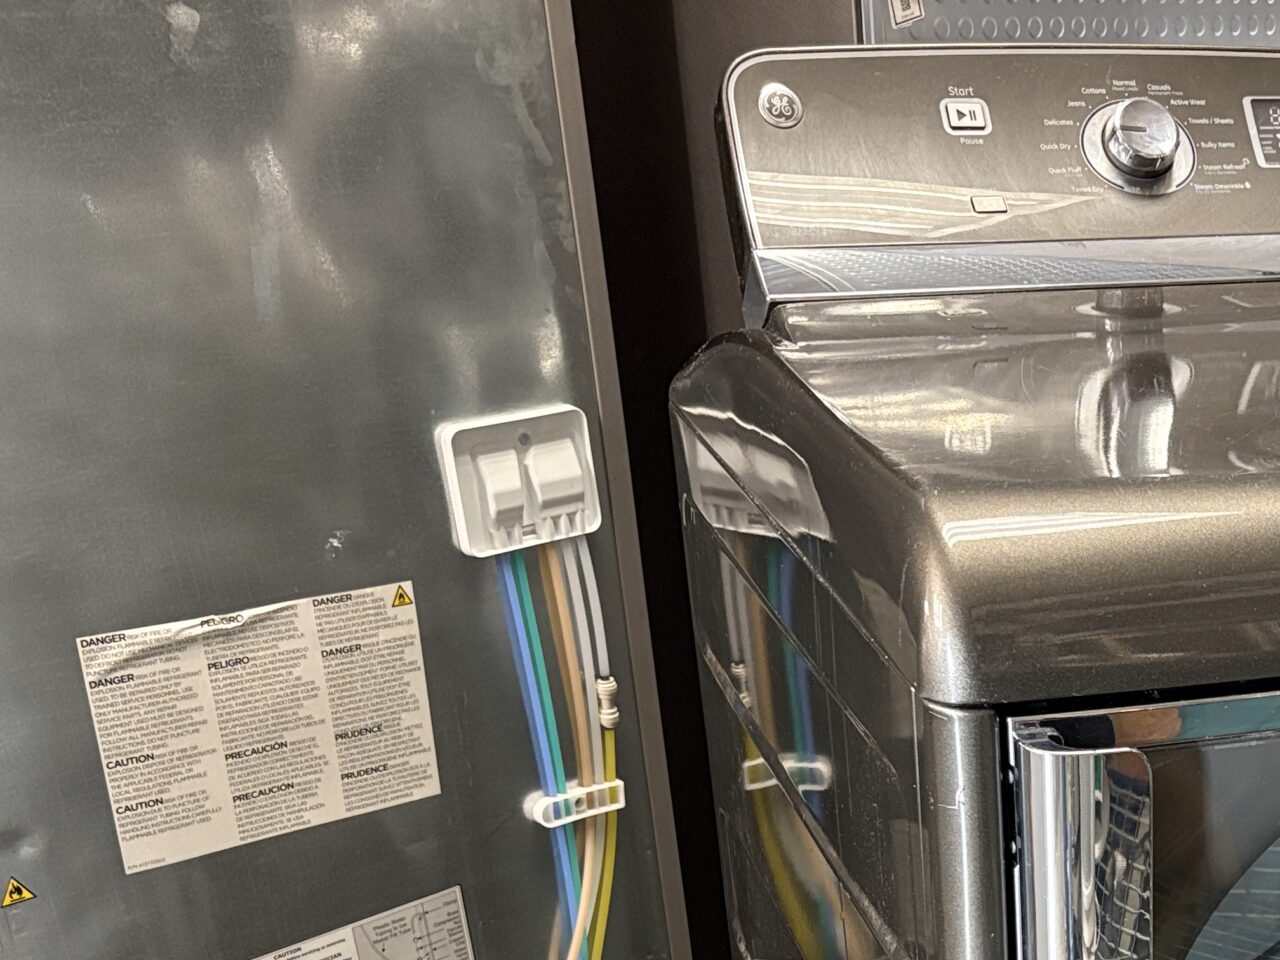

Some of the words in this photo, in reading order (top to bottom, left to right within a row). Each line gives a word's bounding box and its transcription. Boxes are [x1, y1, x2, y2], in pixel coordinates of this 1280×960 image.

[948, 86, 974, 96] Start
[1147, 84, 1171, 92] Casuals
[960, 137, 984, 145] Pause
[1060, 143, 1072, 151] Dry
[1201, 142, 1220, 150] Bulky
[312, 594, 352, 607] DANGER
[80, 633, 126, 647] DANGER
[321, 644, 361, 657] DANGER
[208, 657, 249, 670] PELIGRO
[89, 674, 134, 688] DANGER
[335, 725, 382, 741] PRUDENCE
[224, 741, 287, 761] PRECAUCIÓN
[106, 753, 154, 769] CAUTION
[341, 764, 388, 780] PRUDENCE
[232, 782, 294, 802] PRECAUCIÓN
[115, 798, 163, 814] CAUTION
[273, 947, 301, 960] CAUTION
